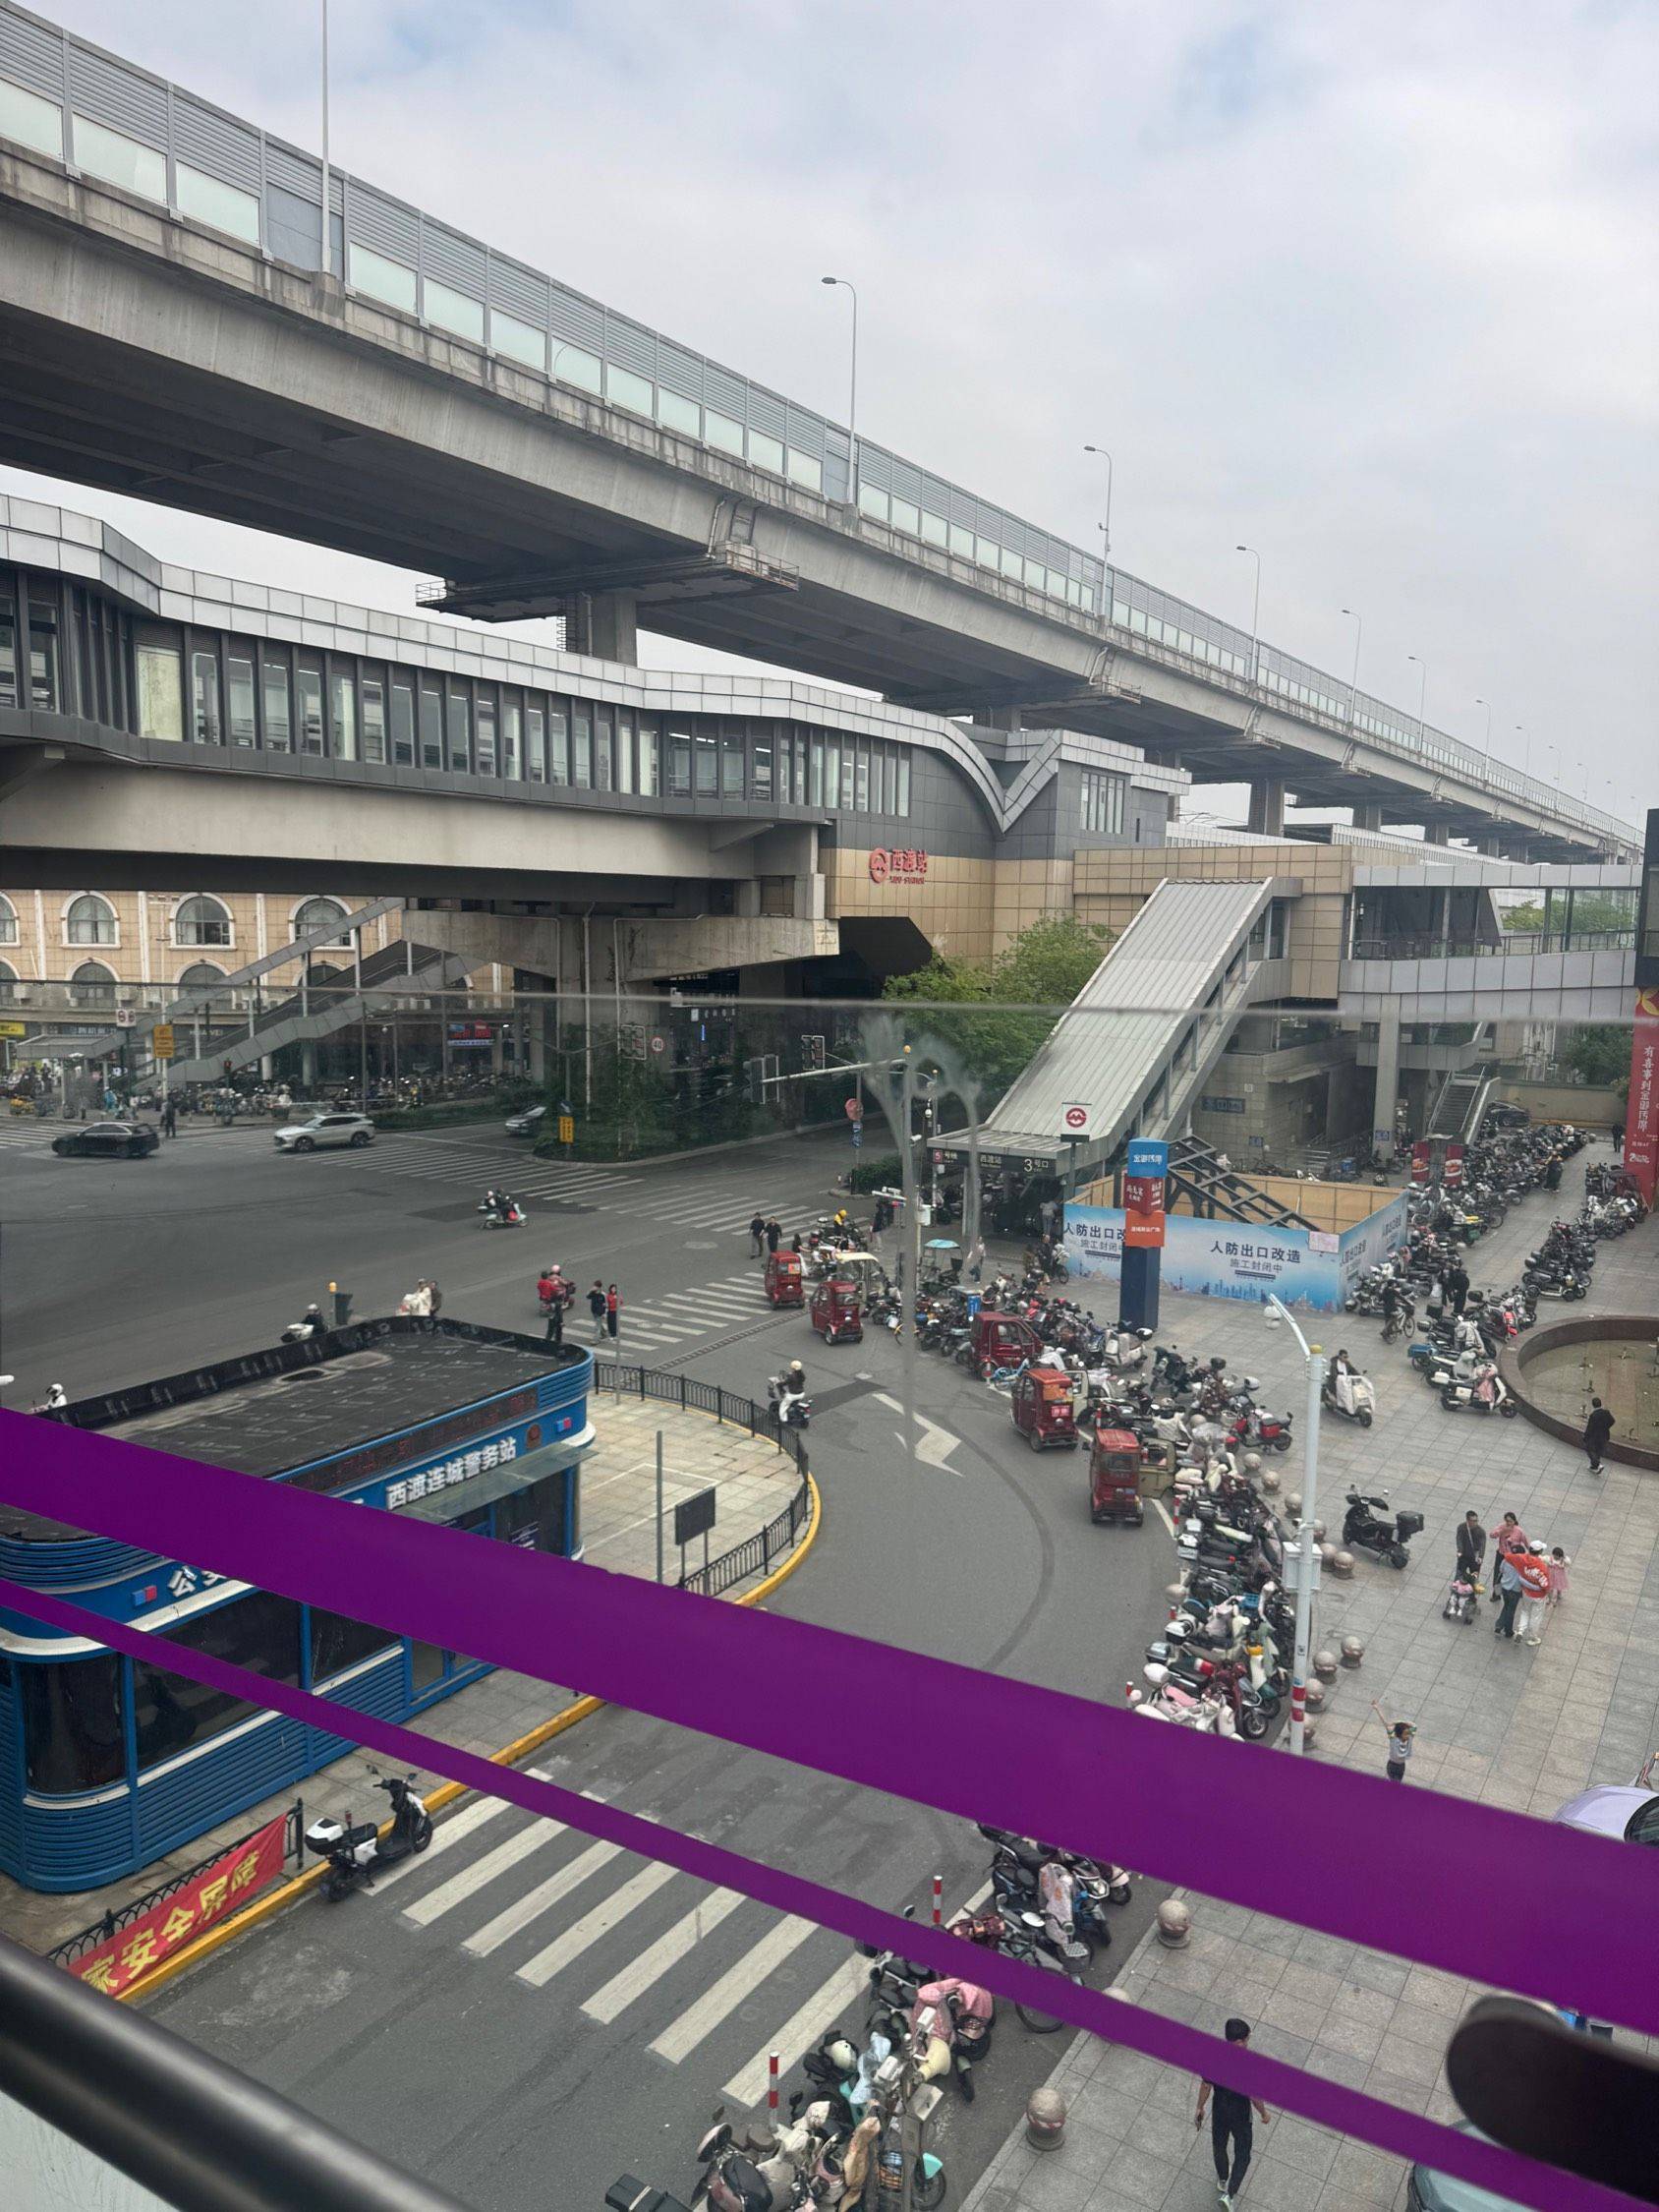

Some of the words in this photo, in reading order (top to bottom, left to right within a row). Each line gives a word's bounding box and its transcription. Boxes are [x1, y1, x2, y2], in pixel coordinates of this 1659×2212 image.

[892, 848, 928, 873] 西渡站
[1080, 1239, 1122, 1252] 施工封闭
[1211, 1240, 1301, 1263] 人防出口改造
[1230, 1257, 1283, 1273] 施工封闭中
[386, 1436, 517, 1511] 西渡连城警务站
[82, 1850, 260, 1995] 家安全屏障
